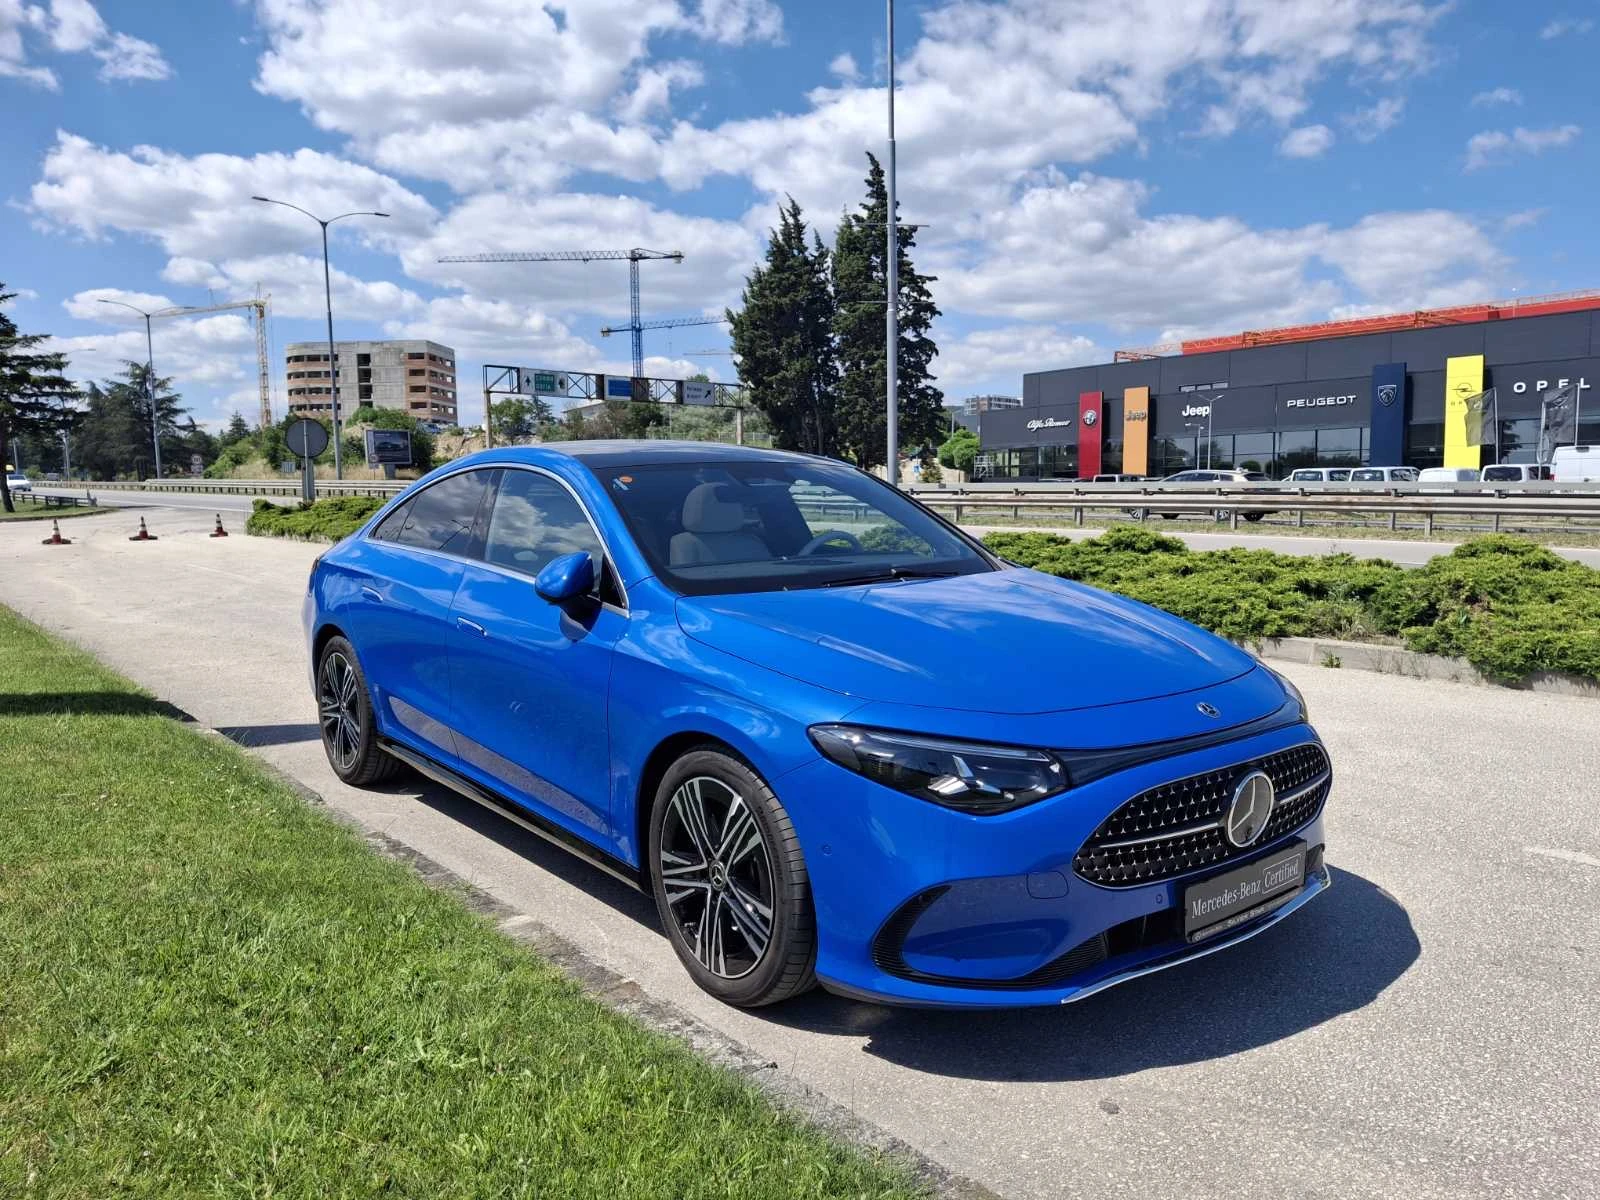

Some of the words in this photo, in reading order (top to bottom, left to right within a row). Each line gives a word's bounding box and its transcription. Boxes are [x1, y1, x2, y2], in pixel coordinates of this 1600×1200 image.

[1513, 377, 1591, 393] OPEL
[1287, 395, 1357, 408] PEUGEOT
[1126, 410, 1147, 422] Jeep
[1182, 404, 1210, 417] Jeep
[1027, 419, 1045, 432] Alfa
[1192, 880, 1261, 919] Mercedes-Benz
[1264, 859, 1298, 887] Certified
